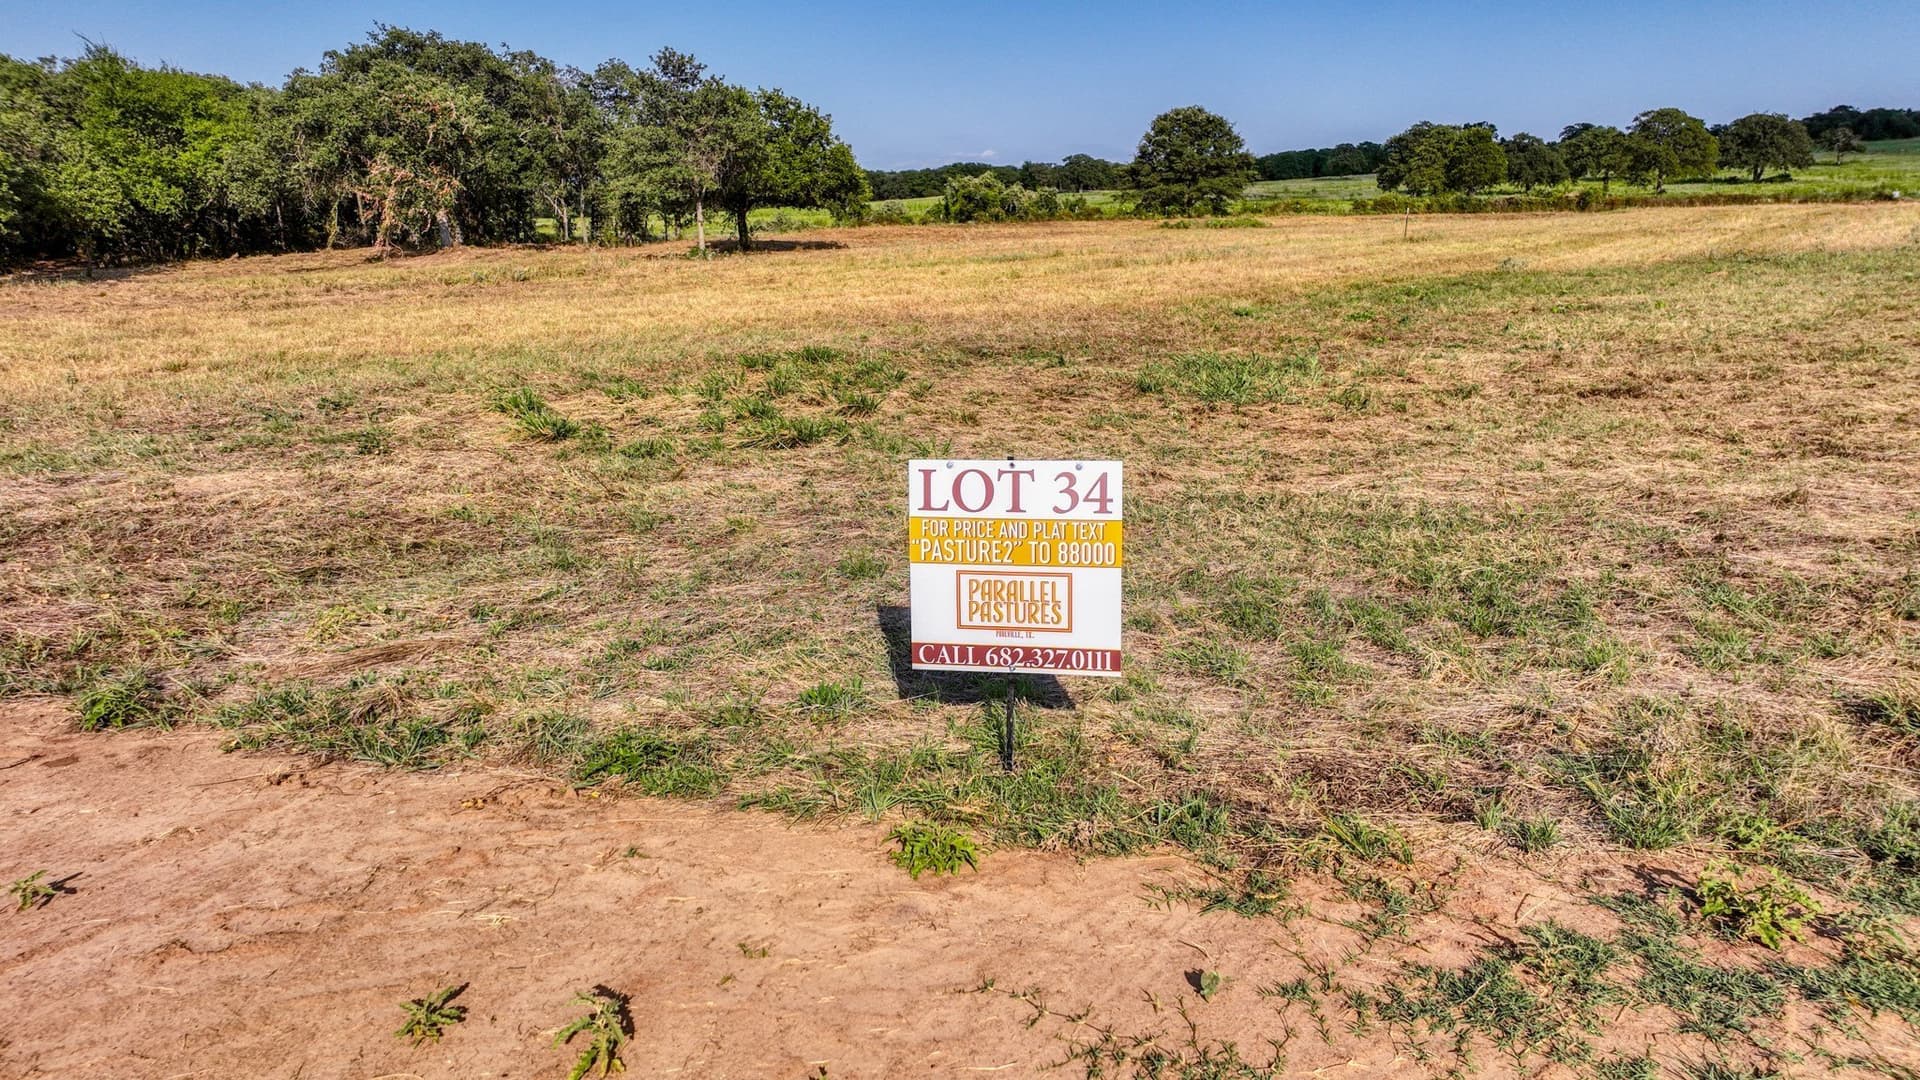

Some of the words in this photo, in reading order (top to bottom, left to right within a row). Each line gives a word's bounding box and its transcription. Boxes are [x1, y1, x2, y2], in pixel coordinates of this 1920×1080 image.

[917, 468, 1035, 513] LOT
[1052, 471, 1114, 514] 34
[921, 519, 950, 537] FOR
[953, 520, 994, 539] PRICE
[999, 521, 1028, 539] AND
[1033, 521, 1067, 540] PLAT
[1071, 522, 1106, 541] TEXT
[1028, 541, 1051, 564] TO
[1058, 542, 1115, 565] 88000
[968, 578, 1061, 604] PARALLEL
[968, 600, 1063, 625] PASTURES
[918, 644, 981, 666] CALL
[985, 646, 1113, 671] 682.327.0111
